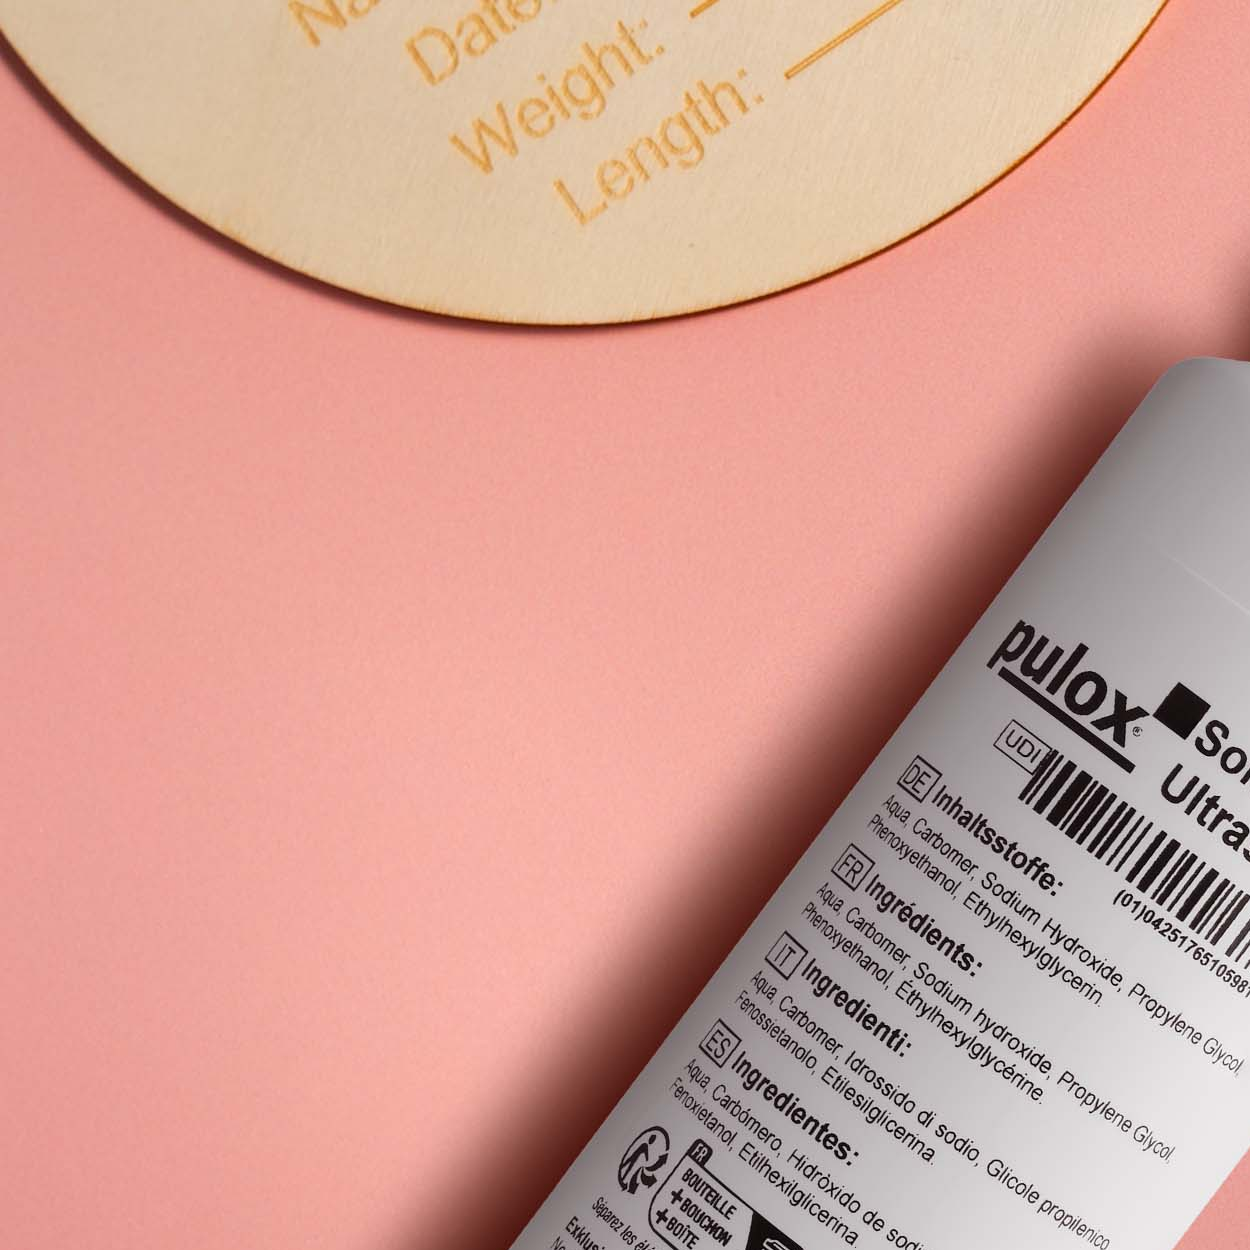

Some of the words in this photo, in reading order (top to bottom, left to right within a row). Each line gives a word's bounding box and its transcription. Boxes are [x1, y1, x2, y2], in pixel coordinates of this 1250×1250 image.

[447, 18, 666, 176] Weight:
[552, 66, 765, 225] Length:
[1005, 728, 1042, 764] UDI
[870, 813, 963, 901] Phenoxyethanol,
[962, 890, 1103, 1005] Ethylhexylglycerin.
[902, 763, 932, 795] DE
[931, 784, 1064, 897] Inhaltsstoffe:
[837, 853, 864, 884] FR
[864, 873, 983, 977] Ingrédients:
[882, 794, 911, 829] Aqua,
[912, 817, 980, 882] Carbomer,
[981, 871, 1041, 926] Sodium
[1041, 917, 1123, 993] Hydroxide,
[1127, 982, 1203, 1045] Propylene
[738, 990, 818, 1076] Fenossietanolo,
[820, 1065, 936, 1166] Etilesilglicerina.
[773, 943, 797, 968] IT
[801, 957, 912, 1058] Ingredienti:
[803, 901, 895, 991] Phenoxyethanol,
[894, 979, 1044, 1105] Éthylhexylglycérine.
[816, 882, 845, 917] Aqua,
[845, 906, 912, 971] Carbomer,
[913, 961, 973, 1016] Sodium
[972, 1007, 1052, 1081] hydroxide,
[1056, 1070, 1133, 1133] Propylene
[673, 1077, 747, 1152] Fenoxietanol,
[738, 1141, 859, 1246] Etilhexilglicerina.
[686, 1058, 711, 1094] Aqua,
[711, 1084, 783, 1159] Carbómero,
[862, 1210, 885, 1232] de
[689, 1141, 711, 1164] FR
[700, 1028, 732, 1059] ES
[731, 1050, 860, 1167] Ingredientes:
[750, 970, 778, 1006] Aqua,
[778, 995, 844, 1061] Carbomer,
[844, 1050, 916, 1114] Idrossido
[917, 1110, 937, 1129] di
[934, 1124, 980, 1167] sodio,
[986, 1159, 1040, 1204] Glicole
[591, 1196, 625, 1233] Séparez
[619, 1225, 638, 1246] les
[681, 1167, 738, 1221] BOUTEILLE
